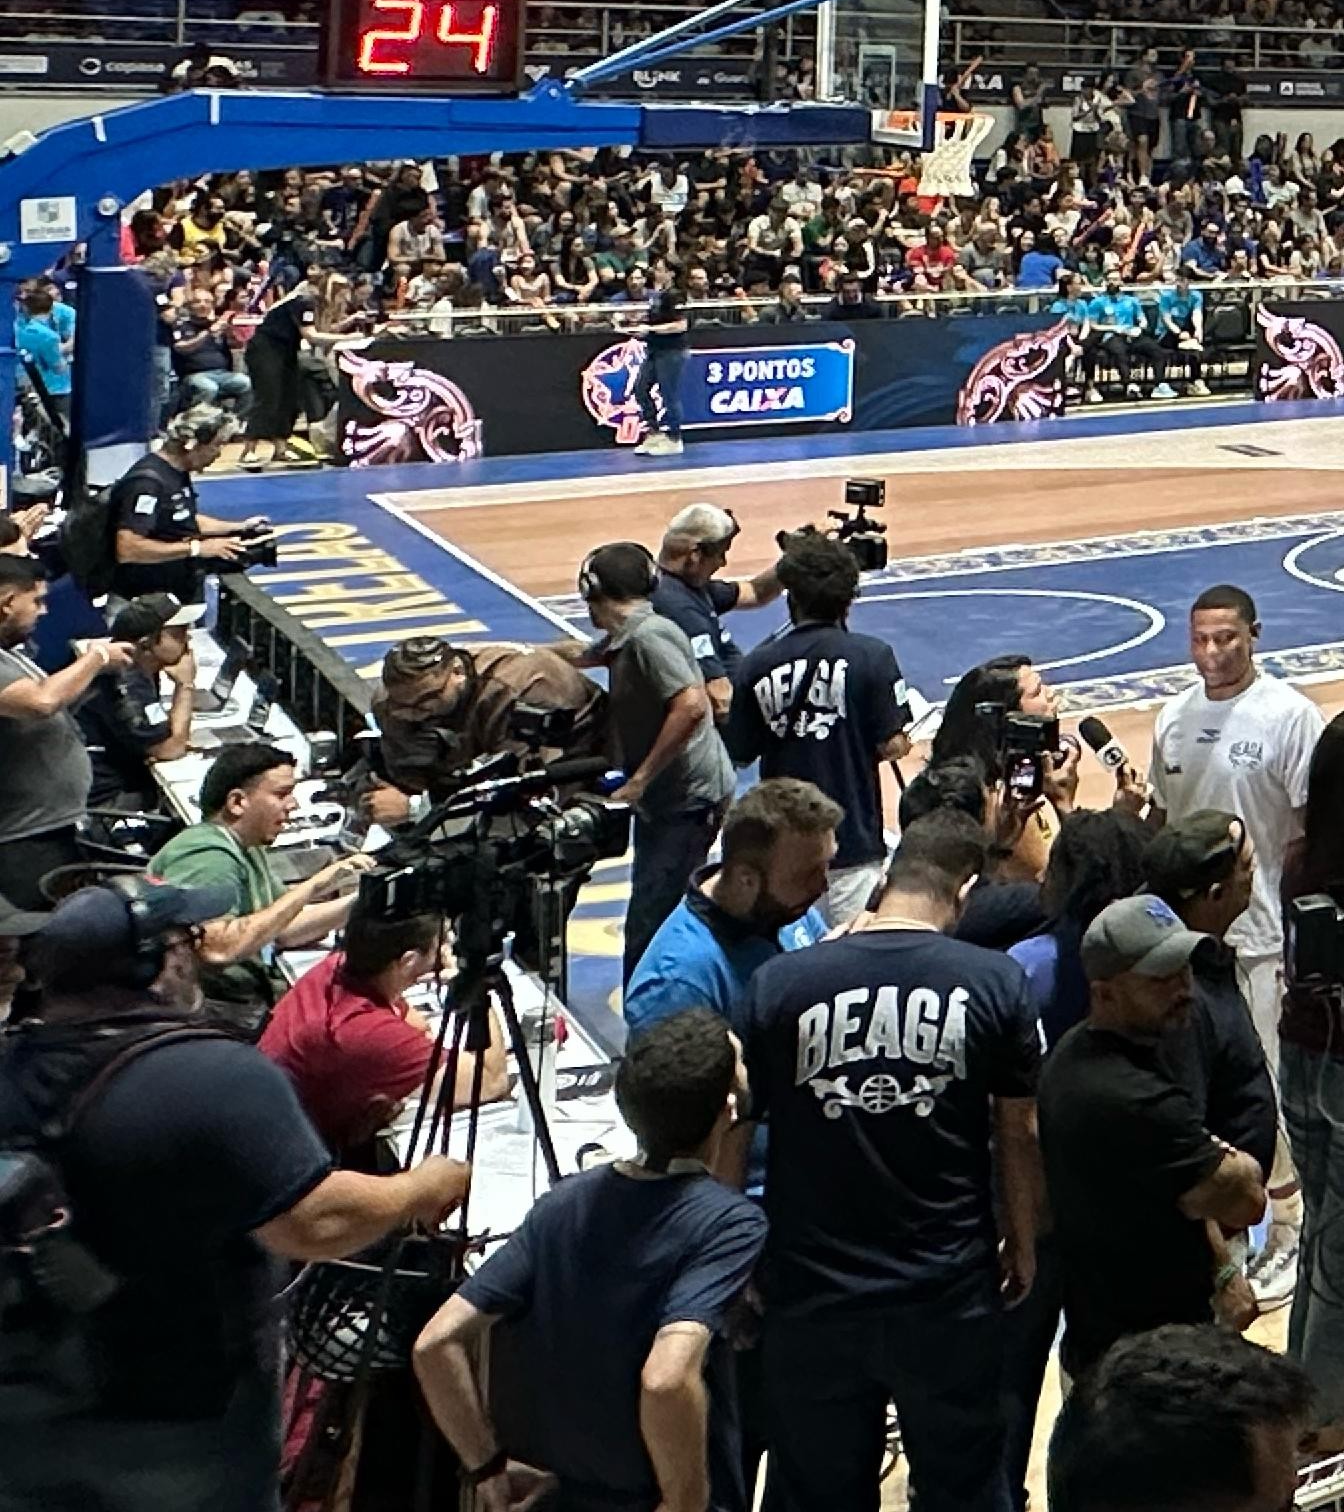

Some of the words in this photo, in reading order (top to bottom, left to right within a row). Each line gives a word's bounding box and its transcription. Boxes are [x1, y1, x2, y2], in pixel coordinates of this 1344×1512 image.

[358, 0, 496, 73] 24
[707, 361, 721, 384] 3
[728, 358, 816, 383] PONTOS
[710, 386, 806, 414] CAIXA
